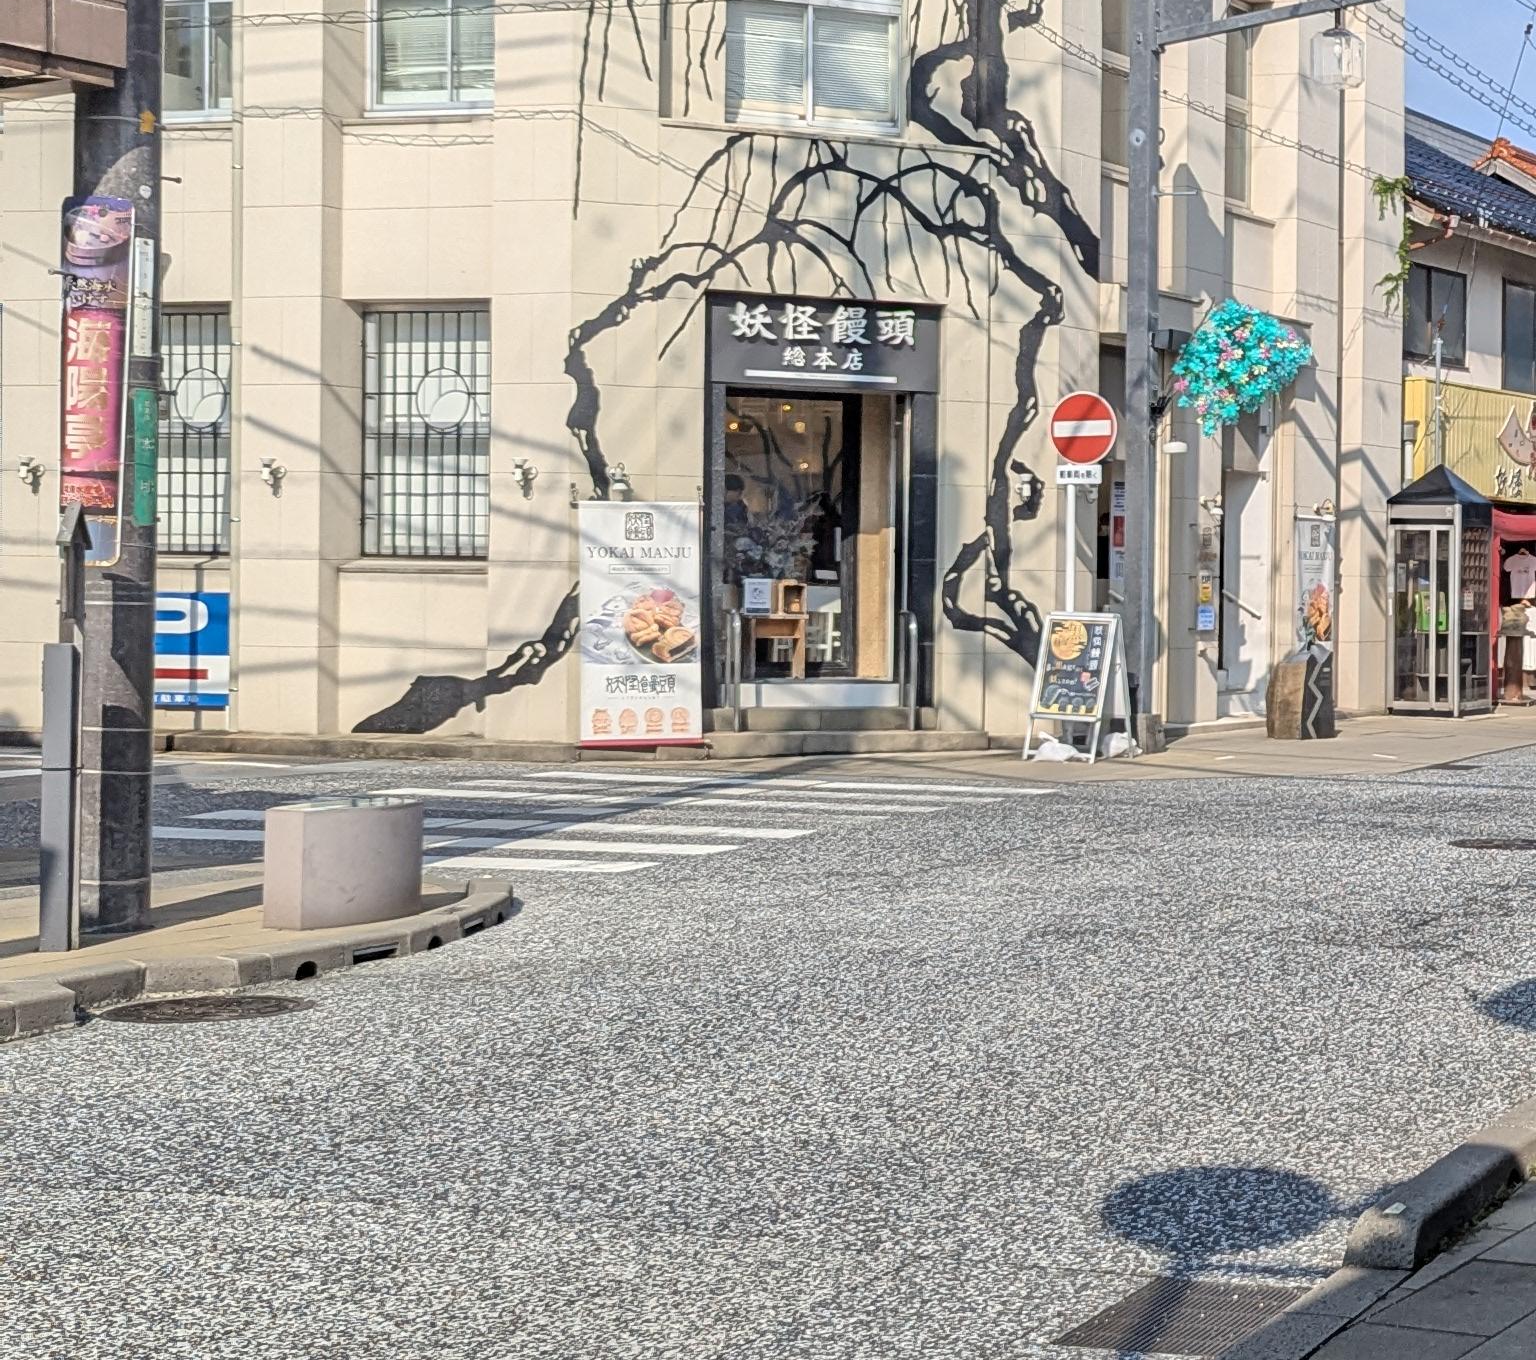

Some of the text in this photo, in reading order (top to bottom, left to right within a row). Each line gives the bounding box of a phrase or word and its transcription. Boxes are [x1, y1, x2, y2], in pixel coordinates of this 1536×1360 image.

[728, 301, 916, 346] 妖怪饅頭
[781, 346, 865, 371] 総本店
[587, 546, 693, 559] YOKAI MANJU
